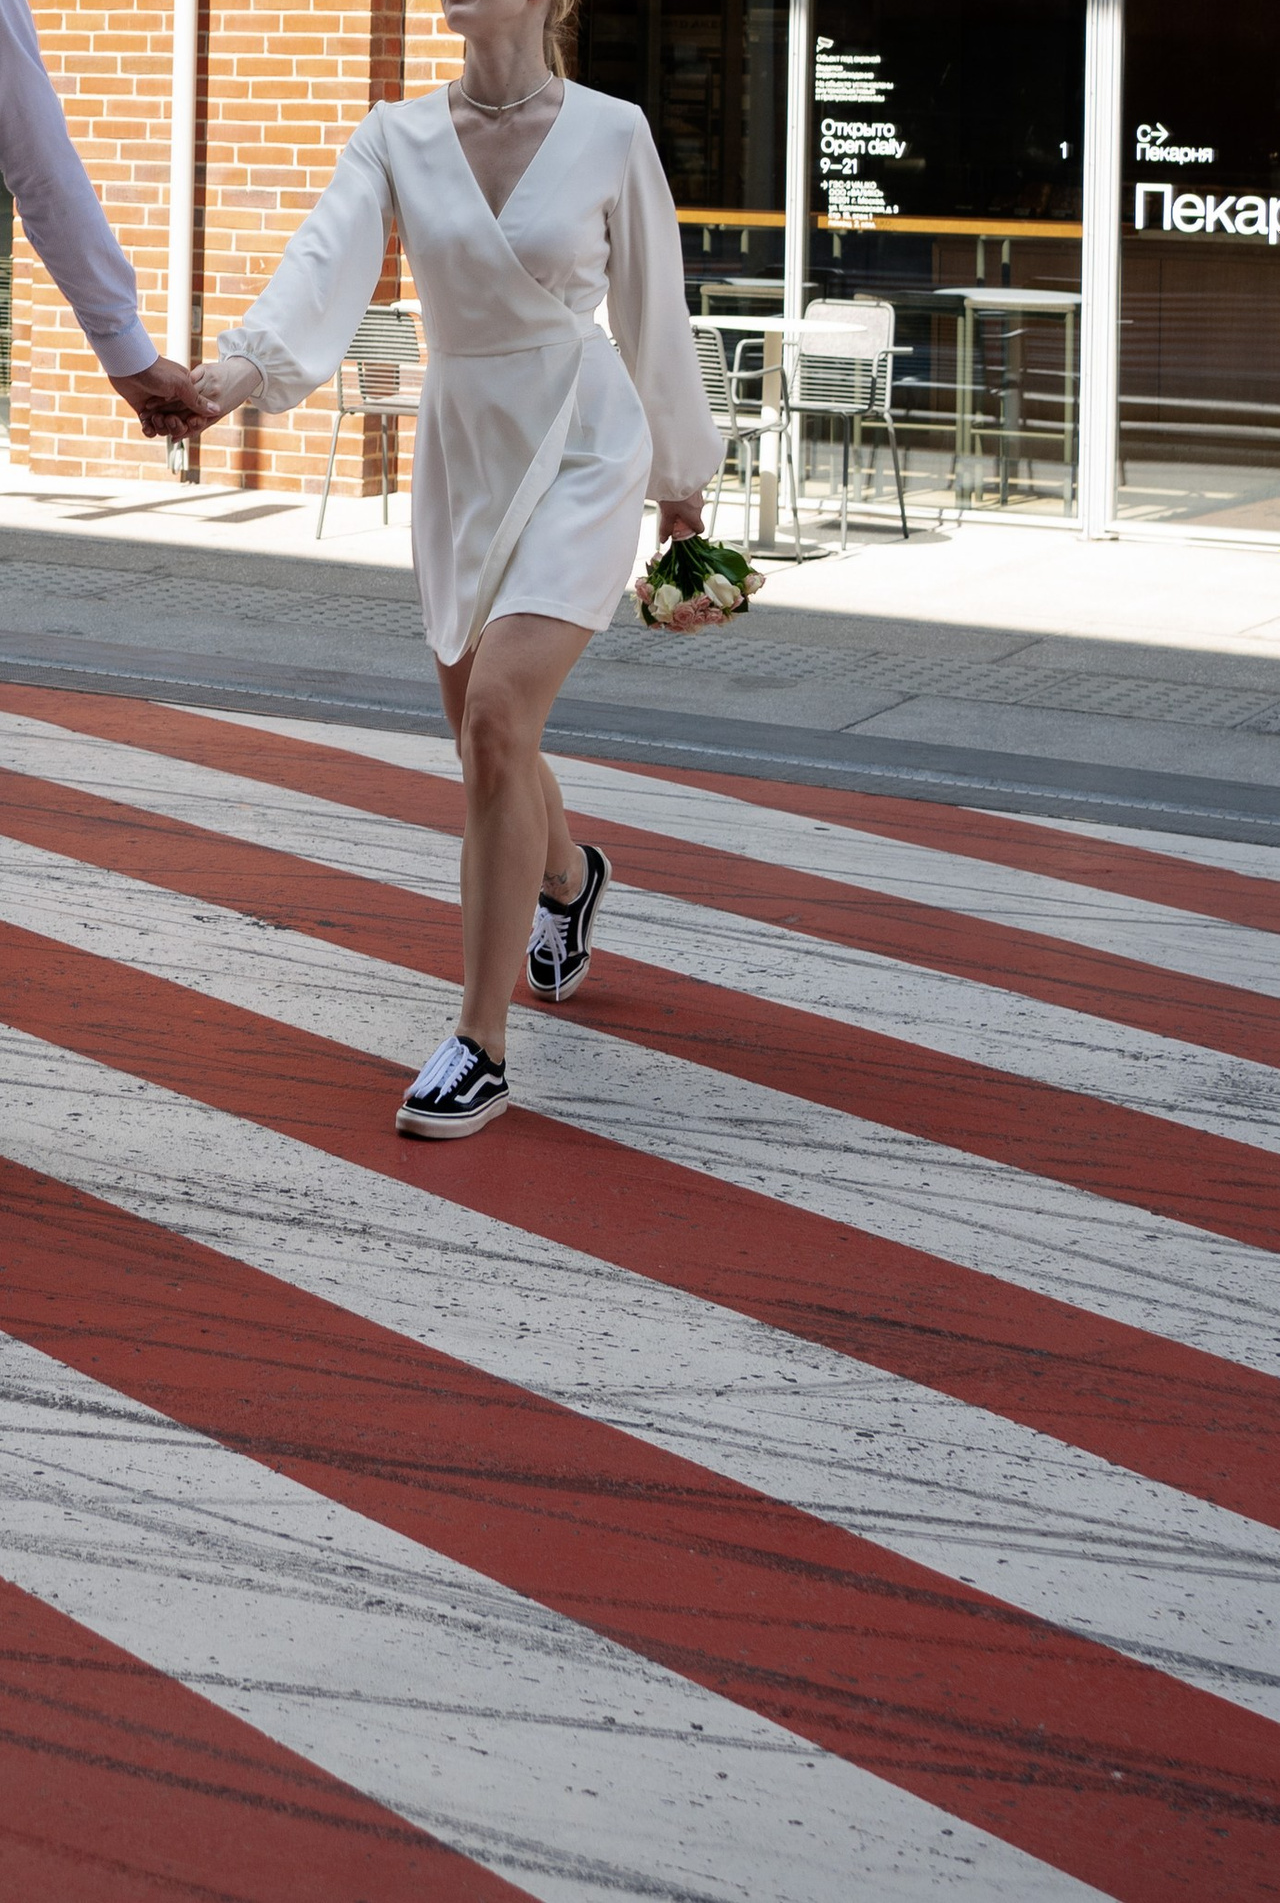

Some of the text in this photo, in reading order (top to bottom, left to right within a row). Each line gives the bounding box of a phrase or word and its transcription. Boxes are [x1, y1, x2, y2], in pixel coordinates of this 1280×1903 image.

[821, 118, 895, 139] Открыто
[821, 136, 906, 159] Open daily
[1060, 141, 1067, 159] 1
[1136, 143, 1213, 165] Пекарня
